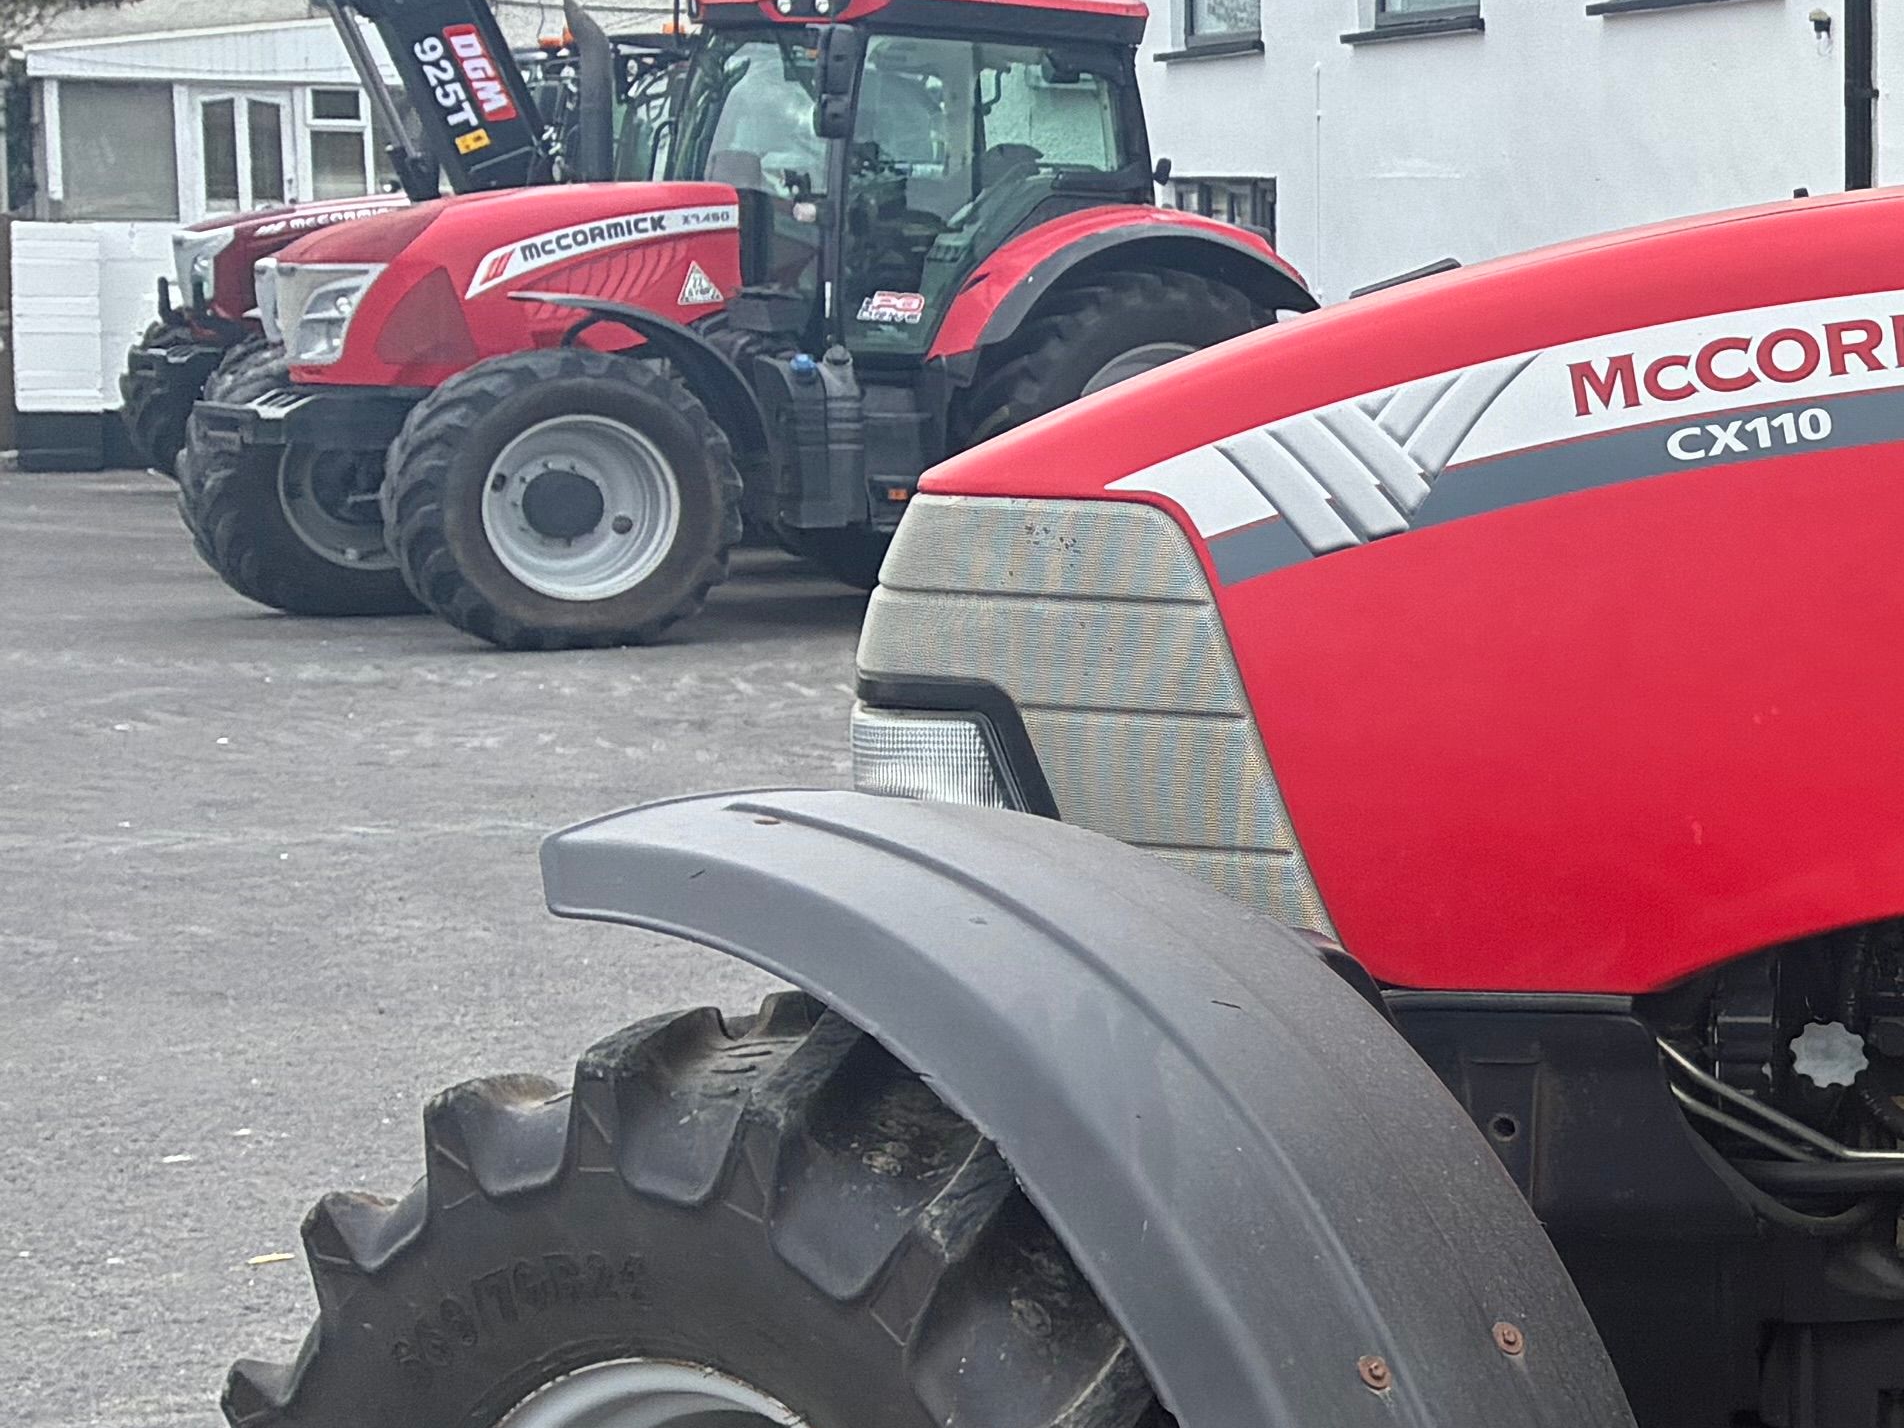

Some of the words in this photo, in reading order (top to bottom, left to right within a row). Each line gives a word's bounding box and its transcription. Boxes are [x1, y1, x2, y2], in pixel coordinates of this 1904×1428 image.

[413, 36, 479, 127] 925T
[449, 32, 509, 114] DGM
[1666, 405, 1833, 462] CX110
